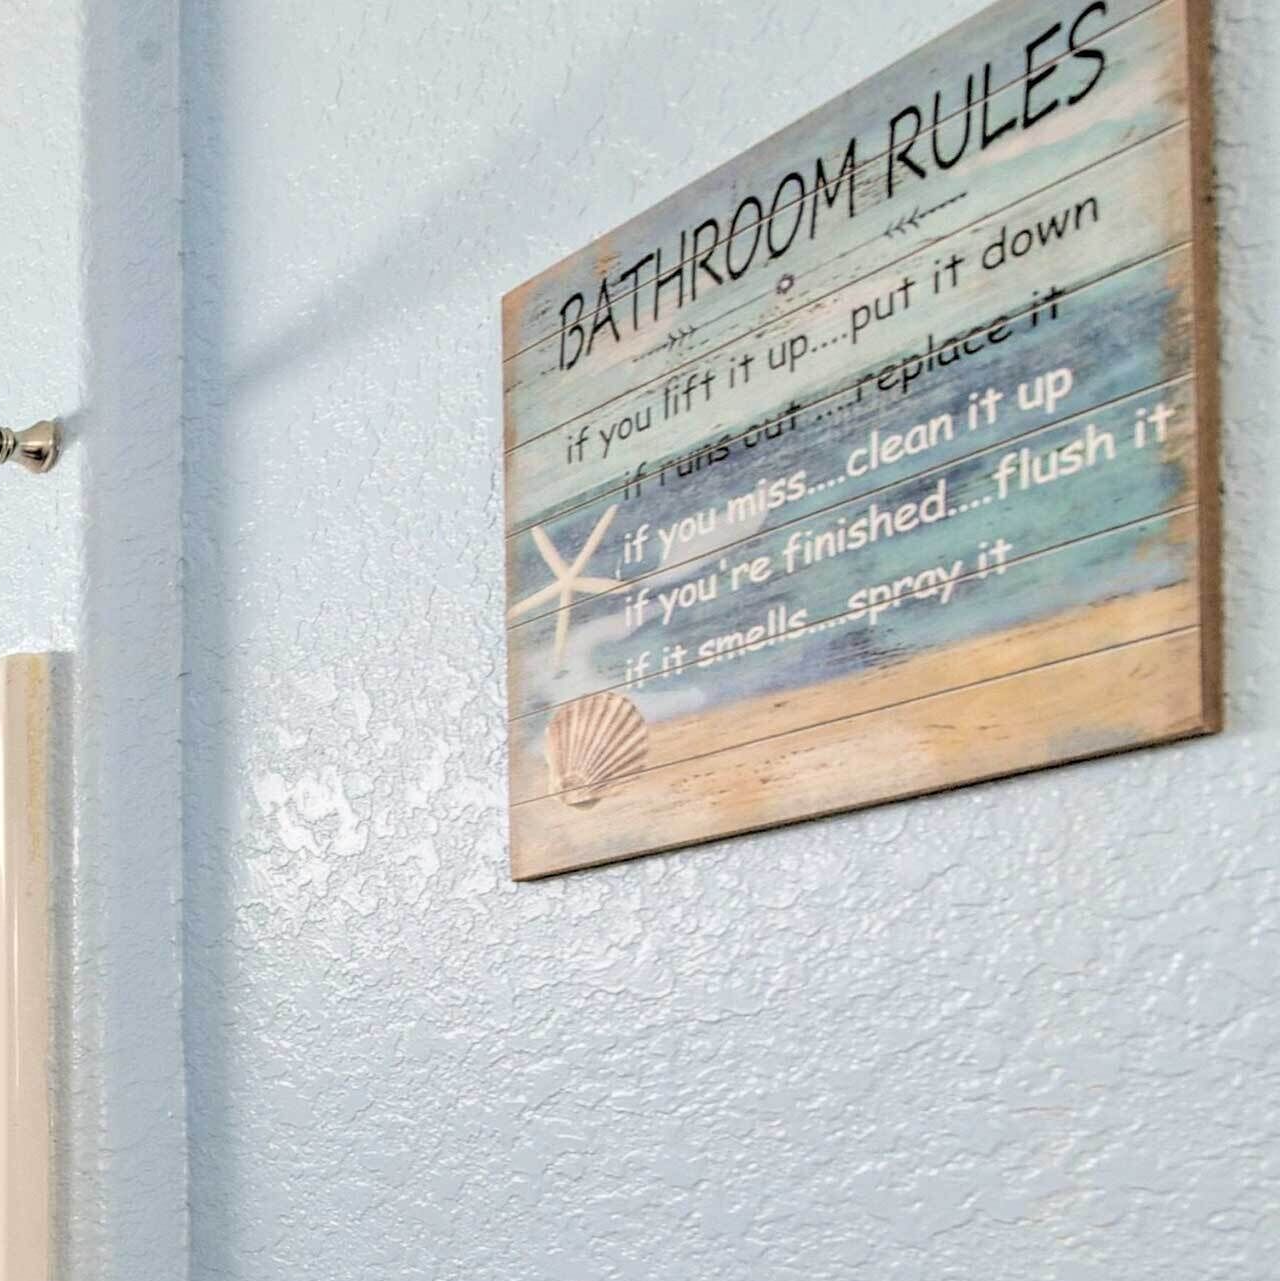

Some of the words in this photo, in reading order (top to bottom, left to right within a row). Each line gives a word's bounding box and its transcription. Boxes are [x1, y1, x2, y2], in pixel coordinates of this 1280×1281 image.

[559, 137, 856, 371] BATHROOM
[888, 1, 1107, 198] RULES
[566, 426, 589, 464] if
[600, 407, 651, 458] you
[664, 370, 716, 419] lift
[729, 354, 755, 388] it
[934, 254, 964, 294] it
[982, 197, 1098, 270] down
[624, 462, 647, 499] if
[659, 434, 730, 486] runs
[744, 401, 801, 448] out
[1030, 286, 1066, 327] it
[624, 524, 648, 563] if
[658, 508, 716, 560] you
[968, 387, 1003, 430] it
[1018, 367, 1073, 413] up
[625, 587, 648, 627] if
[659, 556, 771, 624] you're
[1135, 403, 1175, 448] it
[625, 651, 650, 688] if
[662, 644, 687, 678] it
[977, 539, 1013, 578] it
